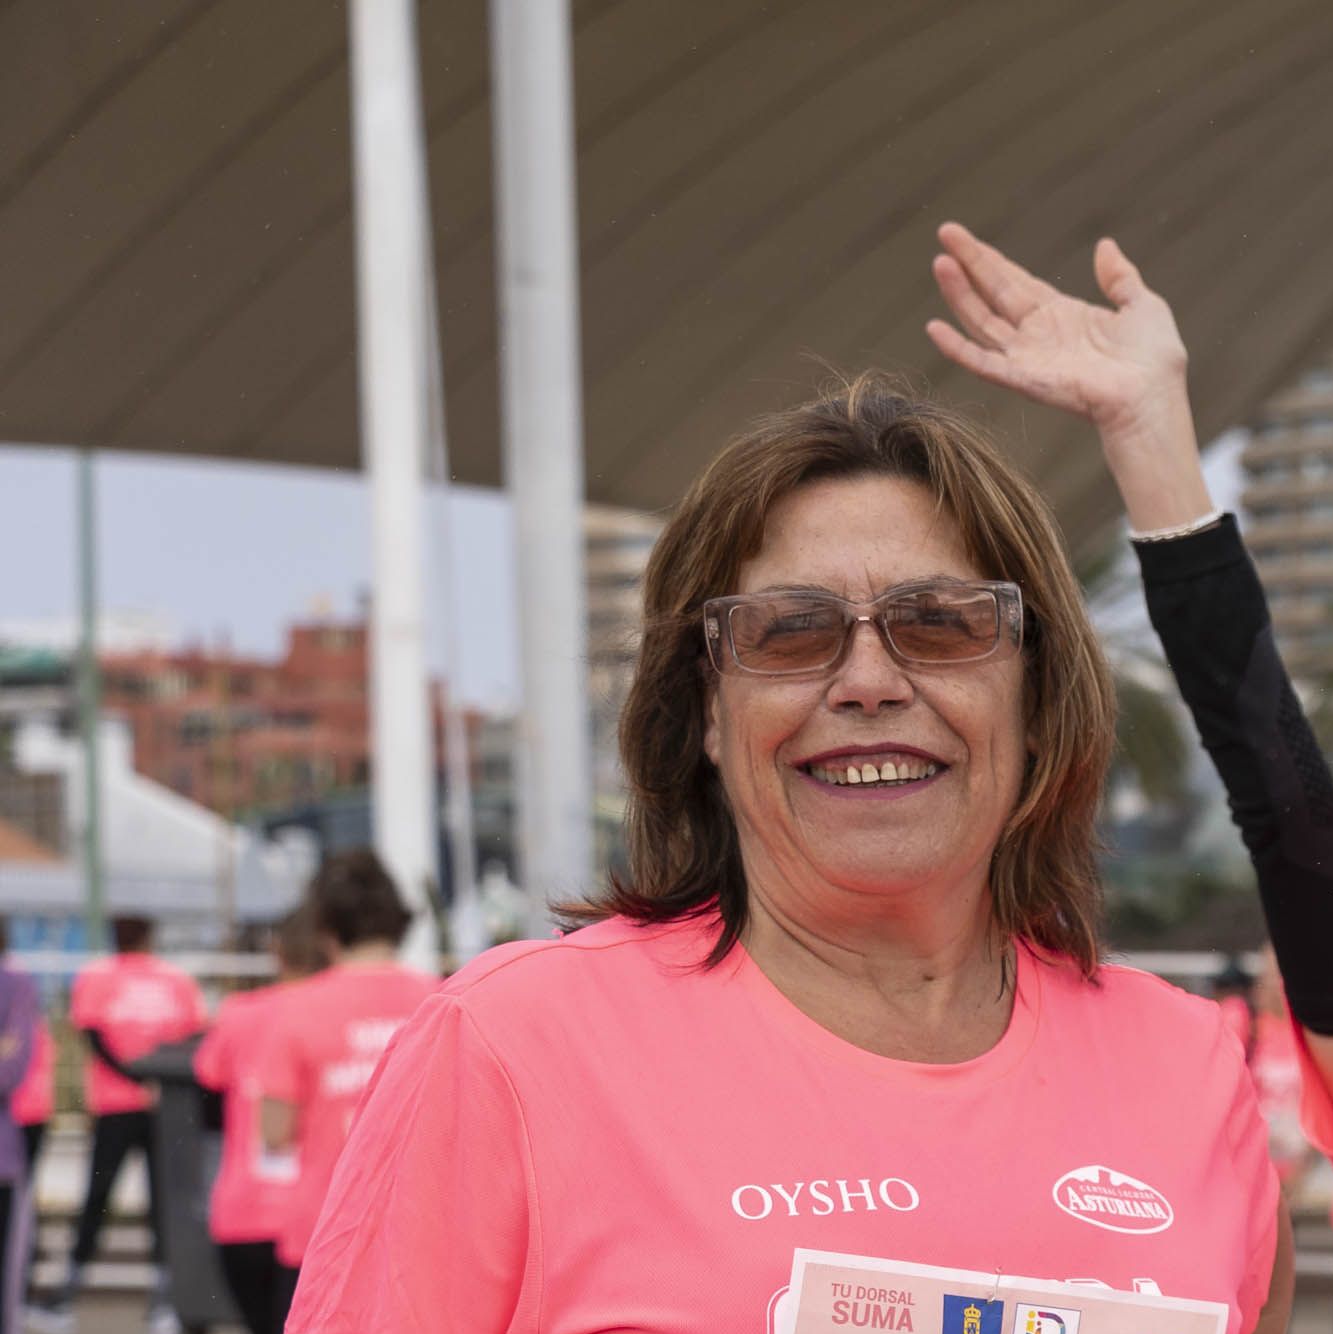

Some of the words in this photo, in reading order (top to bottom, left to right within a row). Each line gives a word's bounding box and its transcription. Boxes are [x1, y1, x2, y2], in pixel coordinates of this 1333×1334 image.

[732, 1178, 919, 1219] OYSHO
[1067, 1185, 1169, 1220] ASTURIANA
[831, 1283, 851, 1298] TU
[856, 1286, 915, 1306] DORSAL
[831, 1300, 914, 1333] SUMA
